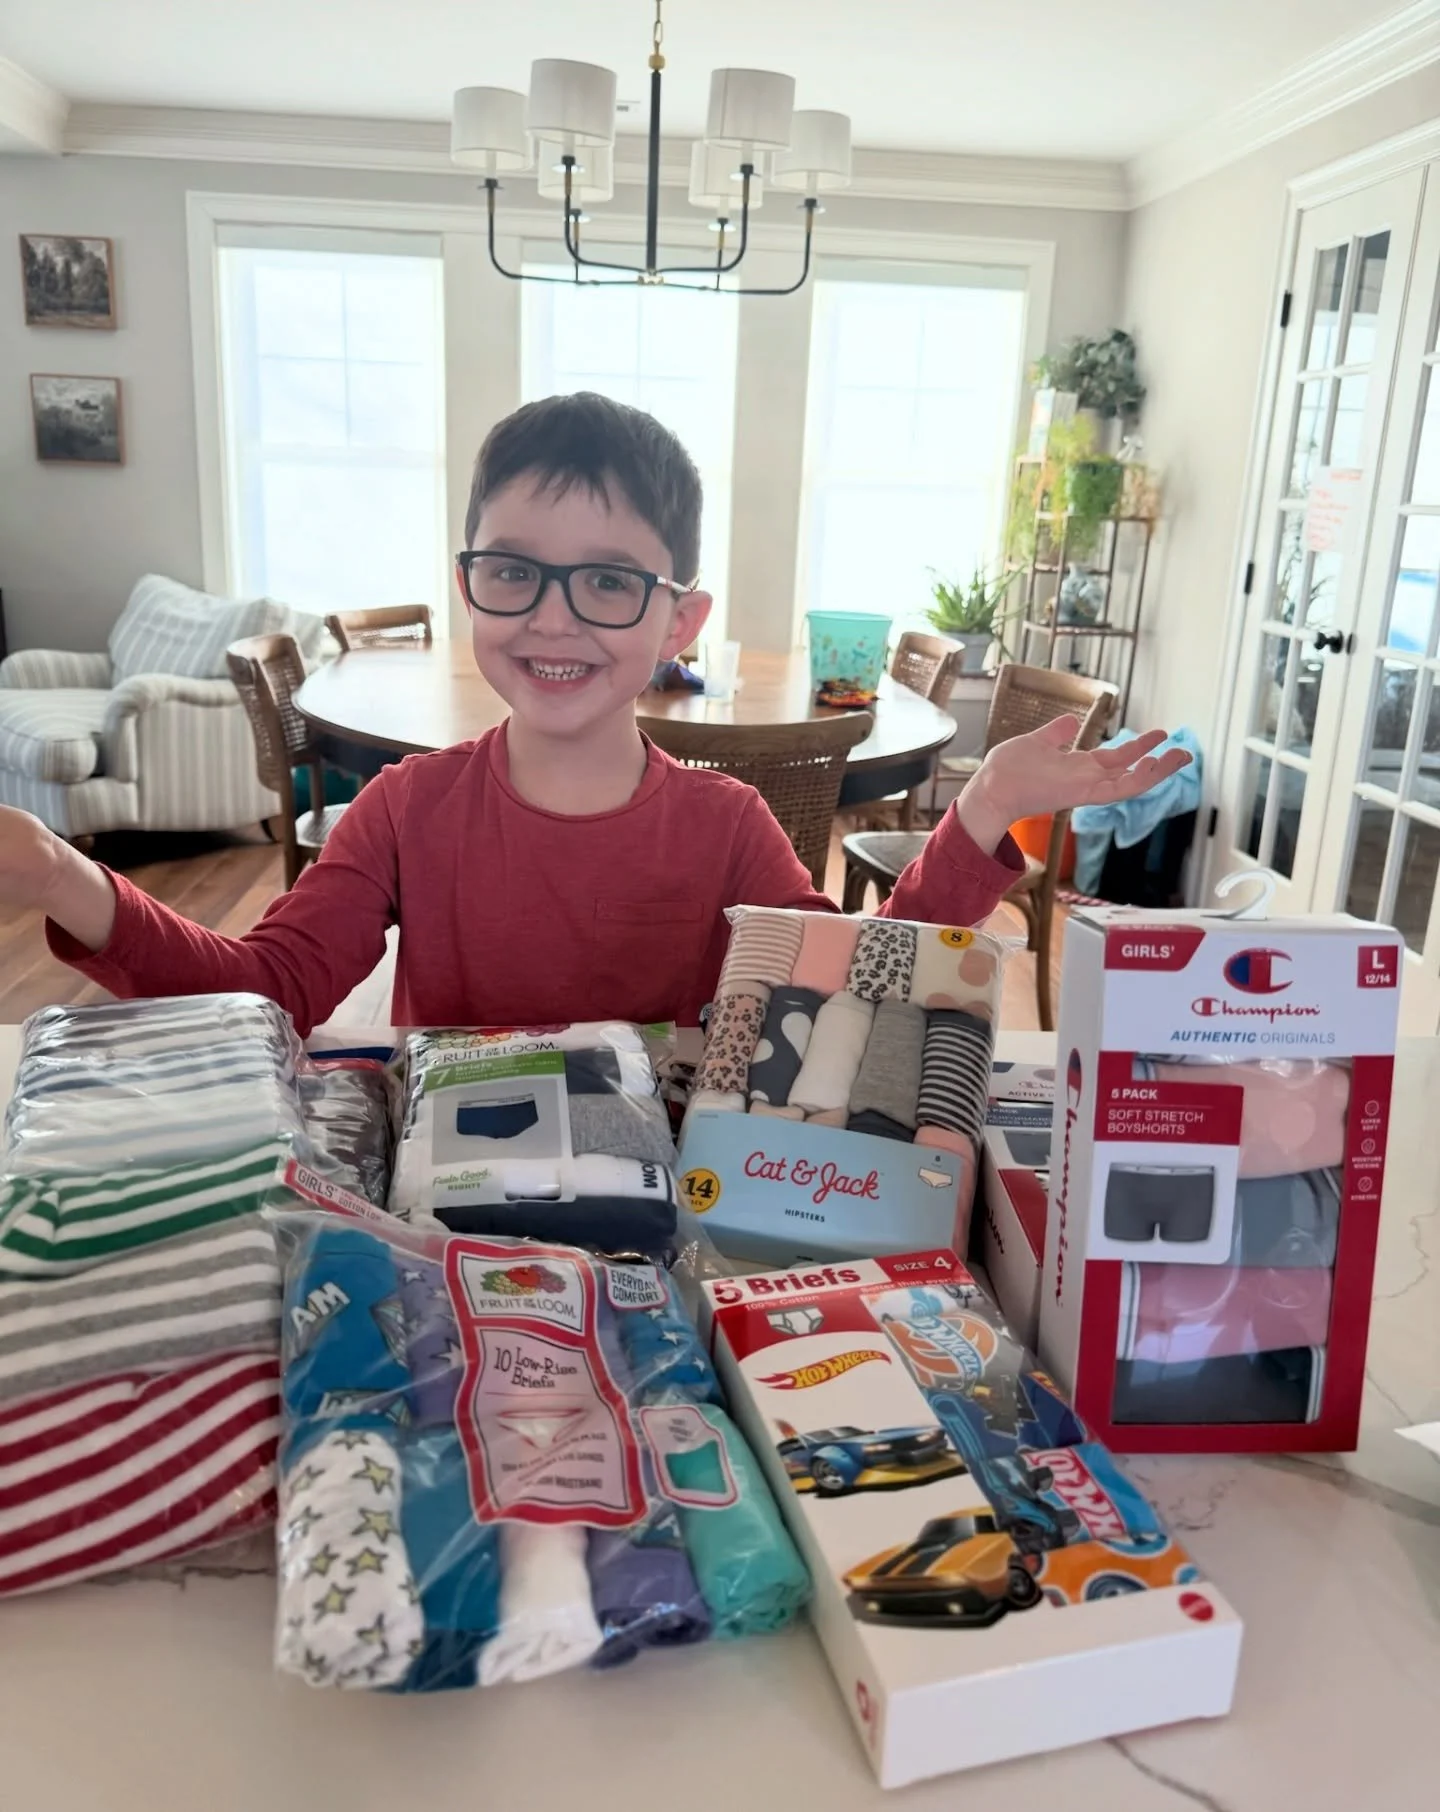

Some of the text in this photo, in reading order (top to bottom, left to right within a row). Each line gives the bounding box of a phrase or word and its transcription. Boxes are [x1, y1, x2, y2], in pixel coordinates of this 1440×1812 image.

[1121, 944, 1175, 958] GIRLS'
[1372, 949, 1385, 969] L
[1365, 973, 1391, 984] 12/14
[1191, 997, 1320, 1024] Champion
[1170, 1030, 1336, 1044] AUTHENTIC ORIGINALS
[433, 1067, 451, 1085] 7
[1111, 1088, 1158, 1100] 5 PACK
[1107, 1109, 1204, 1123] SOFT STRETCH
[1107, 1122, 1186, 1135] BOYSHORTS
[298, 1169, 338, 1199] GIRLS'
[744, 1151, 880, 1204] Cat & Jack
[1056, 1048, 1083, 1306] Champion
[684, 1176, 714, 1199] 14
[784, 1208, 826, 1223] HIPSTERS
[893, 1256, 952, 1272] SIZE 4
[611, 1269, 657, 1292] EVERYDAY
[713, 1267, 862, 1304] 5 Briefs
[480, 1298, 521, 1309] FRUIT
[612, 1284, 660, 1304] COMFORT
[779, 1295, 820, 1305] Cotton
[494, 1346, 578, 1376] 10 Low-Rise
[511, 1366, 556, 1389] Briefs
